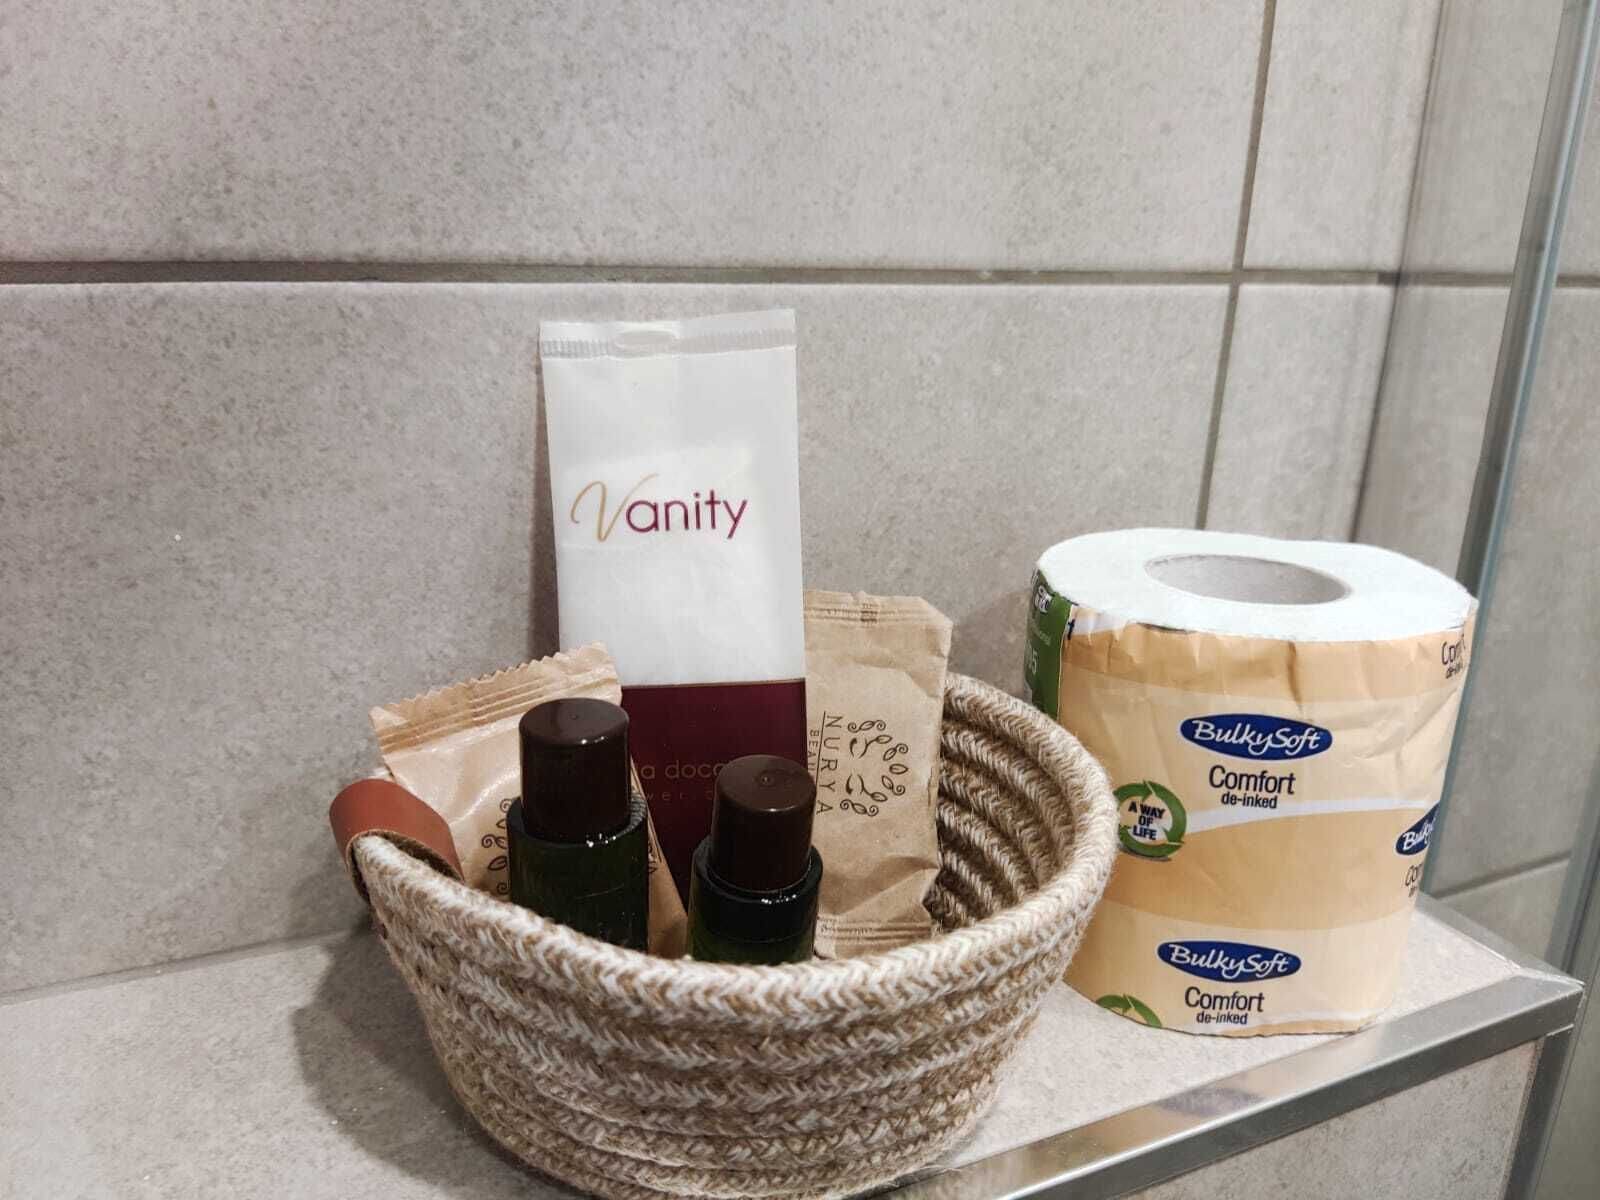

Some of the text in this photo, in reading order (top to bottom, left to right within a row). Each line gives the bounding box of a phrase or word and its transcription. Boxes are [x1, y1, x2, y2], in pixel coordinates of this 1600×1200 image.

[570, 472, 748, 542] Vanity
[1191, 720, 1321, 756] BulkySoft
[816, 714, 843, 815] NURYA
[1208, 764, 1296, 795] Comfort
[1128, 801, 1166, 819] A WAY
[1221, 791, 1278, 809] de-inked
[1132, 825, 1157, 840] LIFE
[1138, 815, 1154, 827] OF
[1168, 943, 1290, 980] BulkySoft
[1184, 986, 1264, 1013] Comfort
[1196, 1010, 1248, 1025] de-inked
